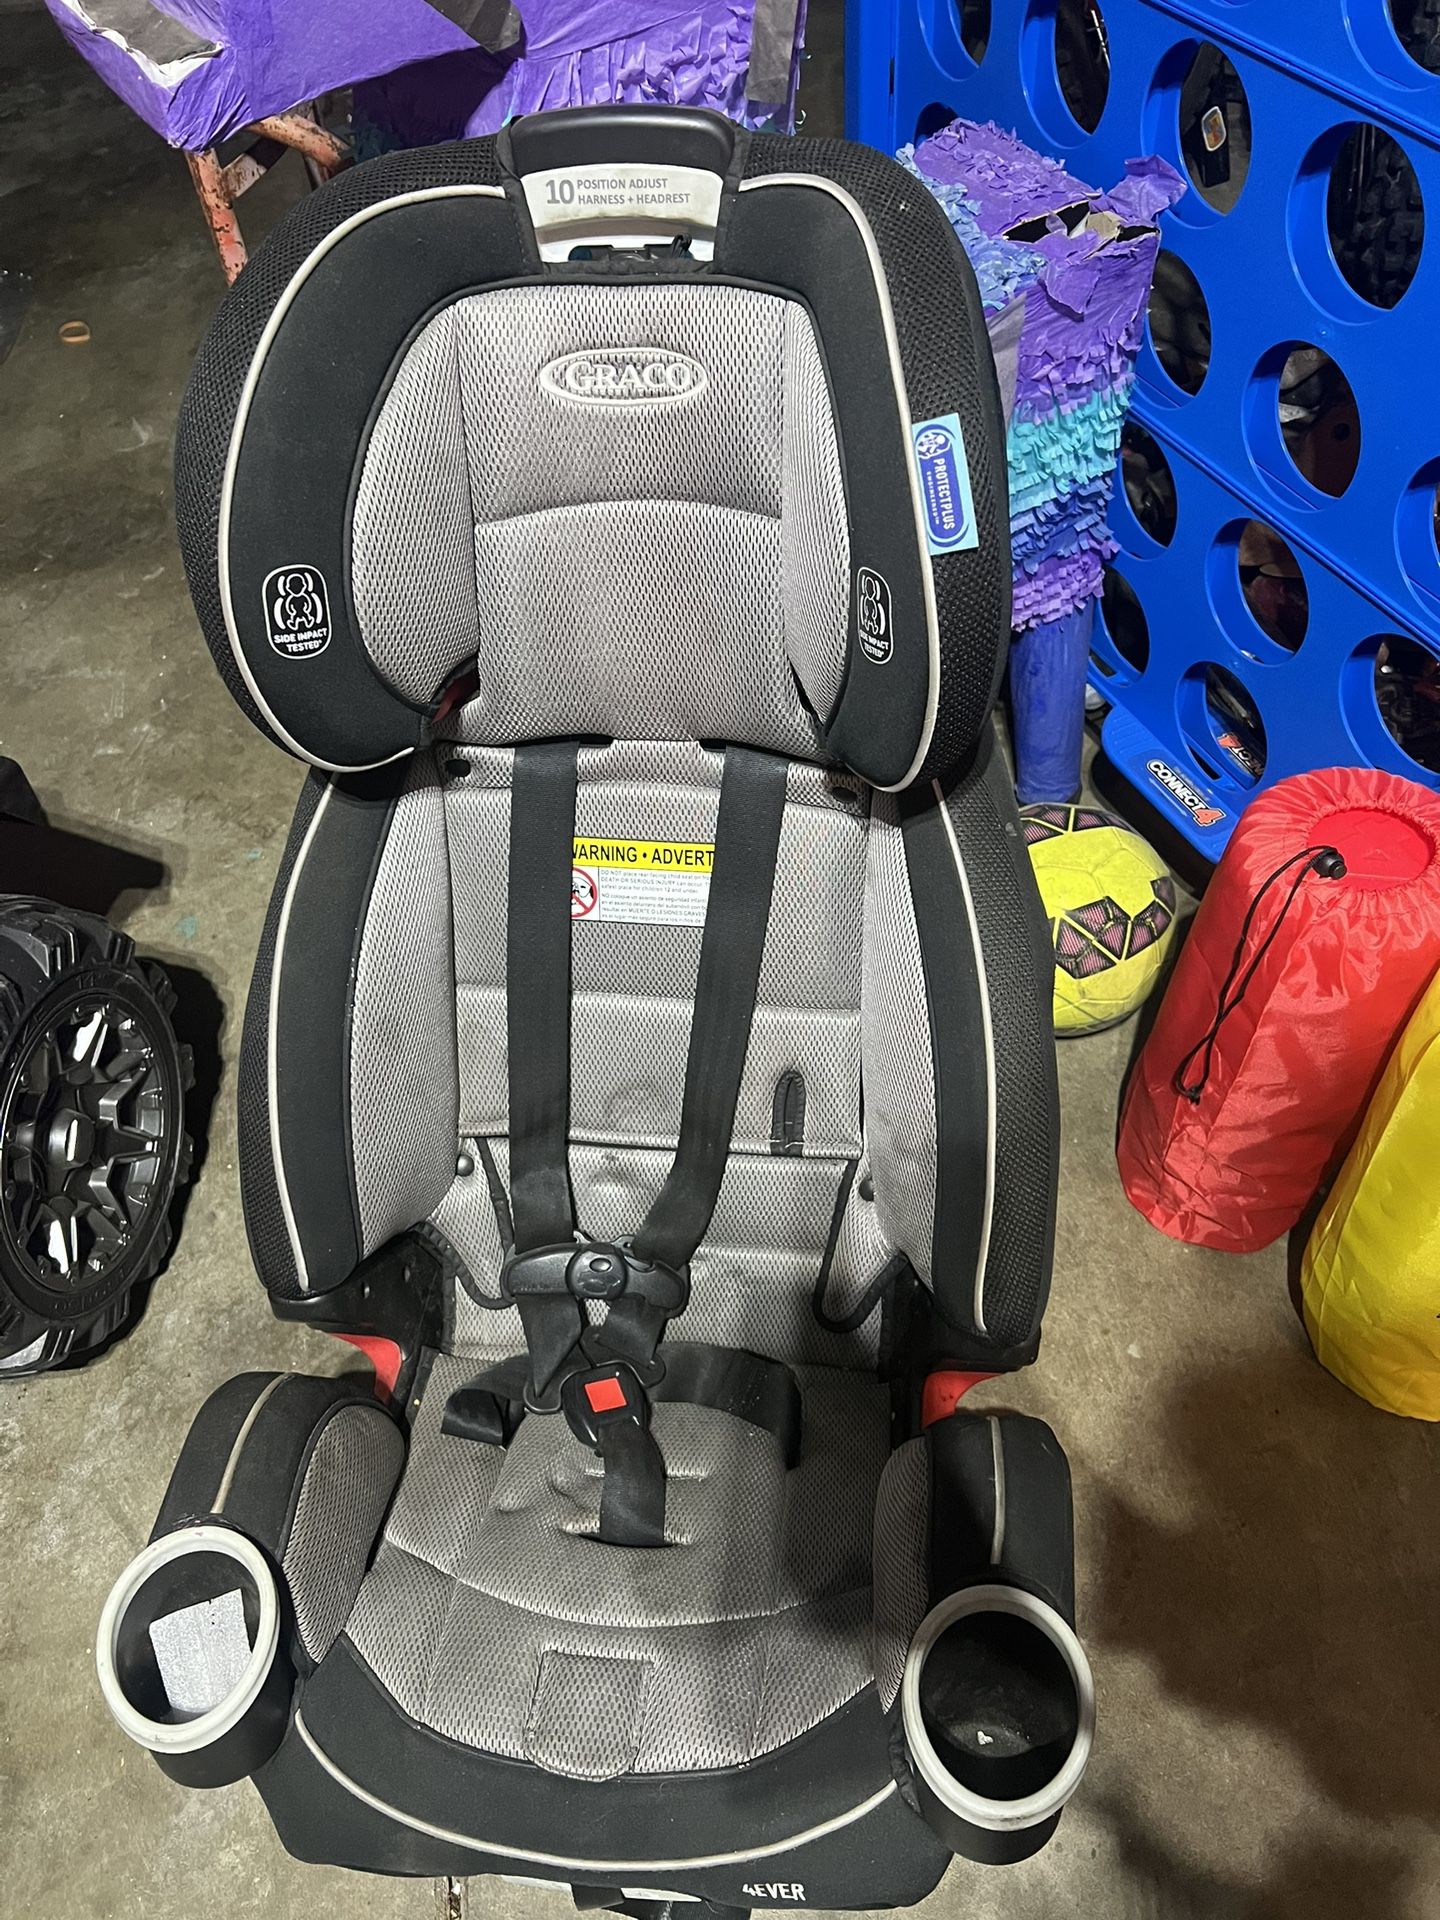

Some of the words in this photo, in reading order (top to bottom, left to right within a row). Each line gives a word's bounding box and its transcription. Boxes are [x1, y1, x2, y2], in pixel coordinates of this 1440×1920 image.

[545, 179, 575, 205] 10
[577, 178, 626, 190] POSITION
[629, 178, 668, 189] ADJUST
[578, 194, 625, 205] HARNESS
[637, 193, 691, 204] HEADREST
[565, 360, 692, 391] GRACO
[933, 457, 956, 530] PROTECTPLUS
[273, 633, 297, 644] SIDE
[297, 627, 328, 642] IMPACT
[742, 1883, 807, 1901] 4EVER
